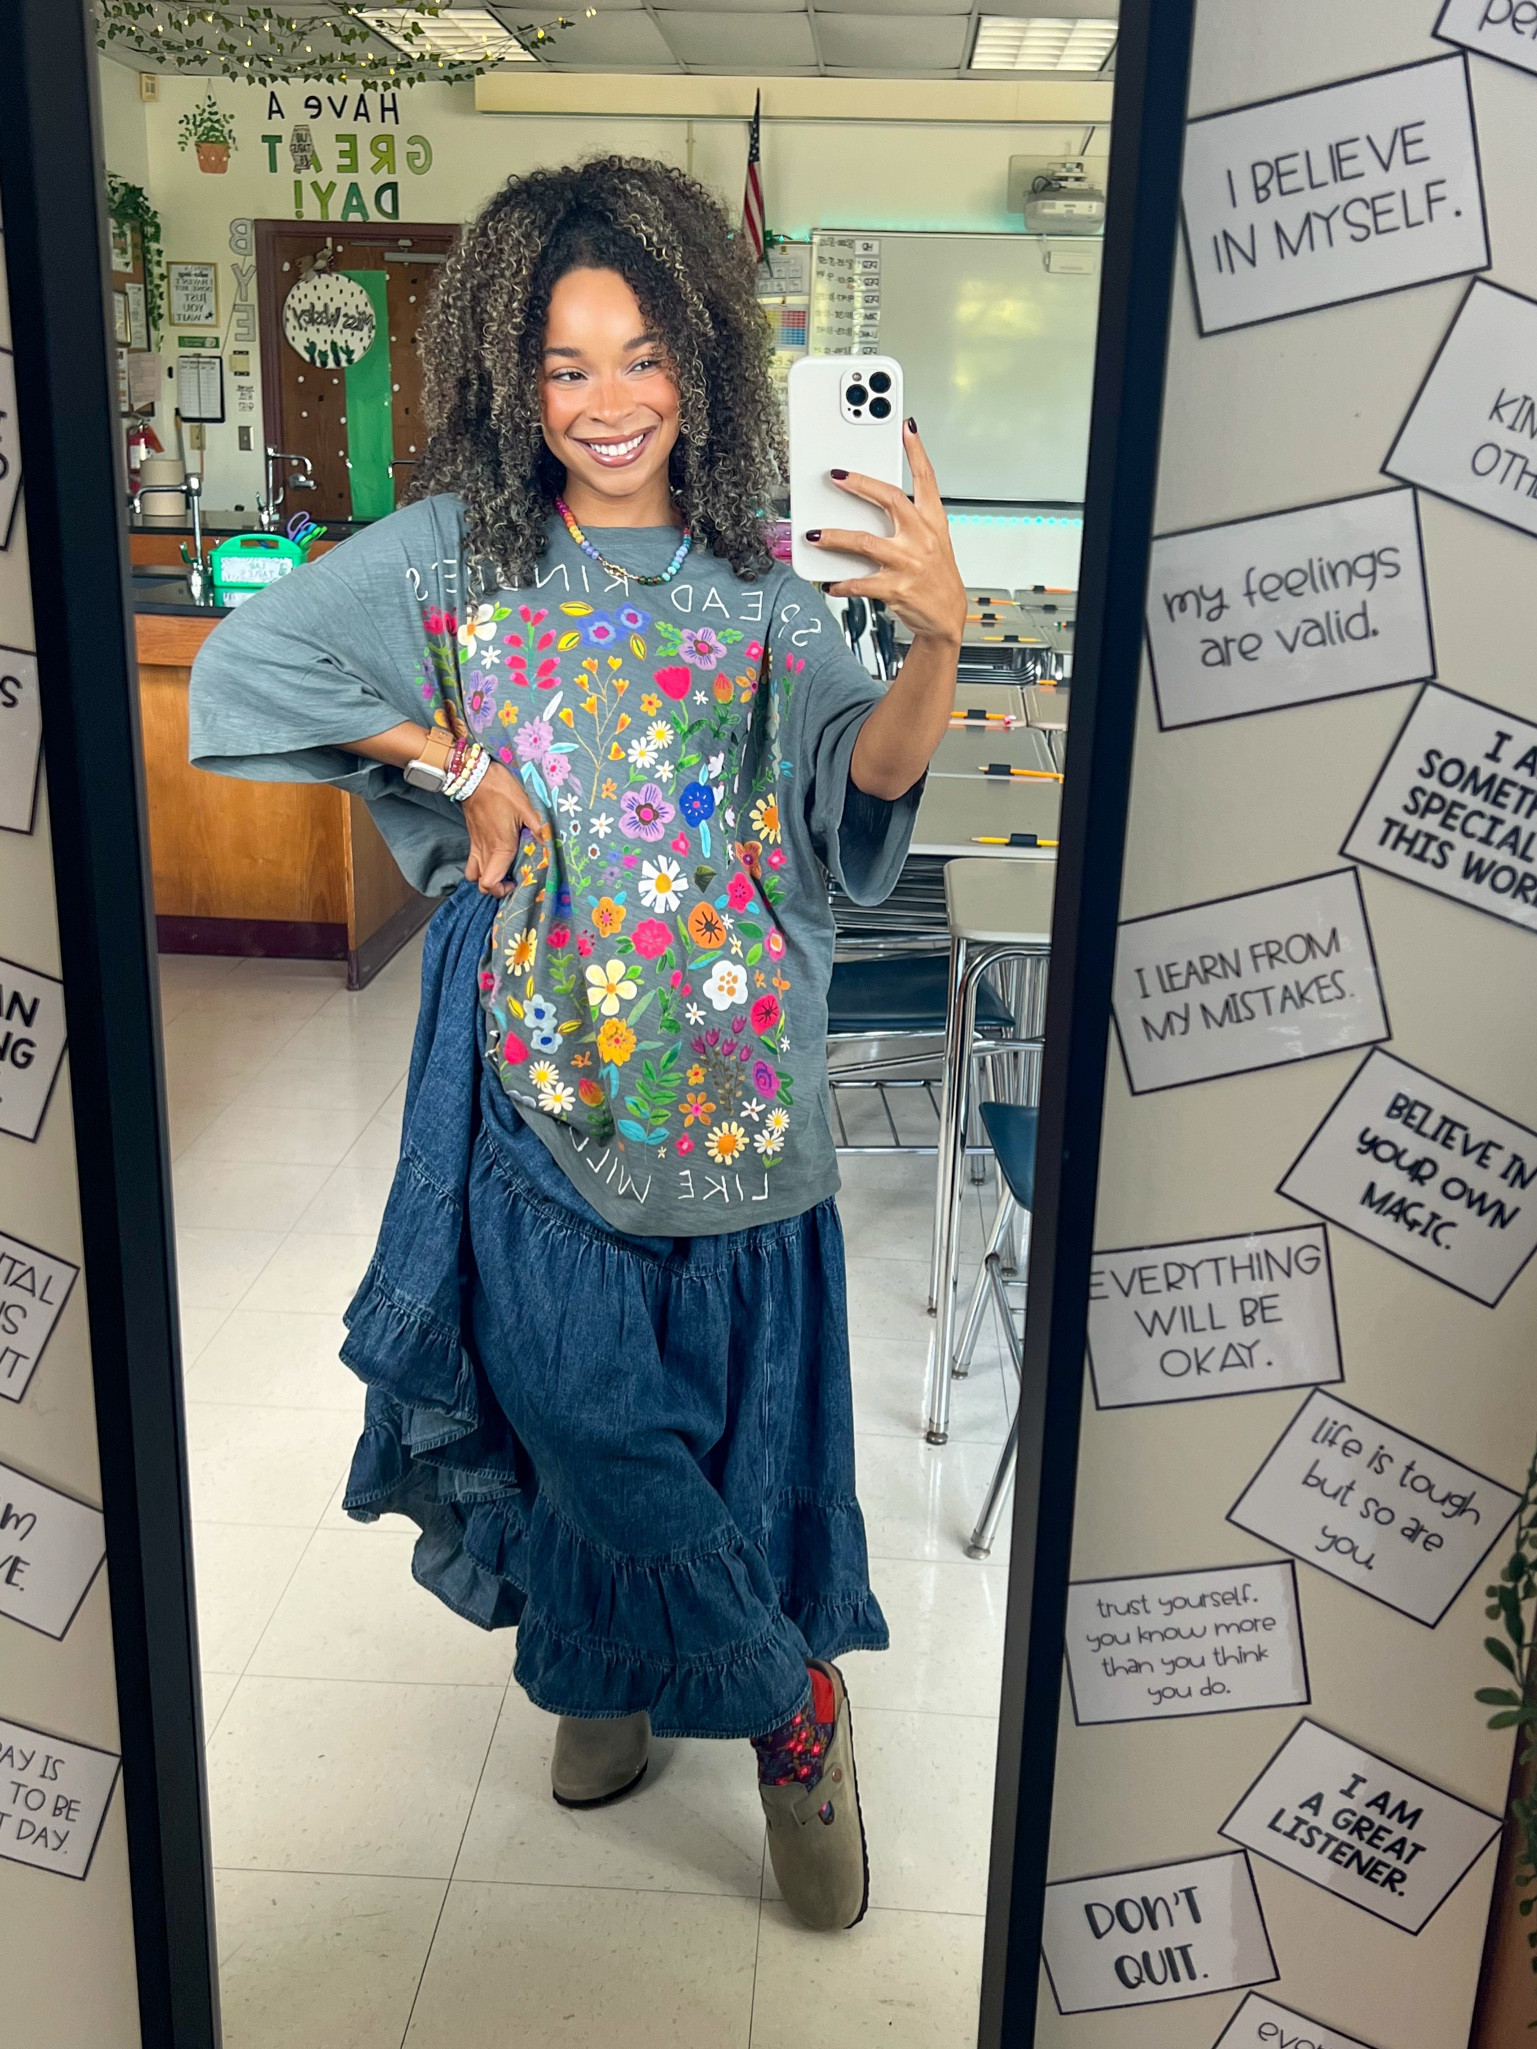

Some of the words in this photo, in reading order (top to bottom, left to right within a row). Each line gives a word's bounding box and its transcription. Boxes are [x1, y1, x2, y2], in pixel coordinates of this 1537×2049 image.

[1478, 0, 1537, 40] pe
[1227, 168, 1238, 208] I
[1251, 120, 1430, 204] BELIEVE
[1213, 223, 1256, 275] IN
[1275, 179, 1463, 260] MYSELF.
[1471, 442, 1537, 500] OTH
[1163, 584, 1230, 622] my
[1243, 546, 1401, 608] feelings
[1200, 632, 1263, 667] are
[1275, 600, 1380, 654] valid.
[1483, 730, 1513, 763] I
[1402, 786, 1537, 863] SPECIAL
[1378, 816, 1456, 869] THIS
[1461, 850, 1537, 906] WOR
[1134, 967, 1149, 999] I
[1156, 948, 1242, 994] LEARN
[1249, 926, 1341, 974] FROM
[1141, 1002, 1190, 1042] MY
[1200, 969, 1356, 1030] MISTAKES.
[1385, 1092, 1504, 1169] BELIEVE
[1499, 1153, 1537, 1190] IN
[1359, 1181, 1460, 1250] MAGIC.
[1440, 1176, 1521, 1229] OWN
[0, 1252, 54, 1305] TAL
[1089, 1244, 1321, 1300] EVERYTHING
[1135, 1302, 1226, 1338] WILL
[1240, 1294, 1283, 1327] BE
[1160, 1339, 1273, 1378] OKAY.
[1311, 1416, 1363, 1459] life
[1367, 1445, 1395, 1475] is
[1399, 1460, 1481, 1525] tough
[1302, 1459, 1356, 1508] but
[1360, 1494, 1396, 1526] so
[1400, 1517, 1444, 1552] are
[1096, 1592, 1150, 1620] trust
[1159, 1583, 1259, 1614] yourself.
[1086, 1629, 1131, 1653] you
[1136, 1622, 1207, 1645] know
[1214, 1615, 1277, 1637] more
[1101, 1655, 1154, 1679] than
[1163, 1651, 1206, 1678] you
[1212, 1644, 1270, 1668] think
[1147, 1683, 1193, 1705] you
[1199, 1676, 1232, 1698] do.
[0, 1742, 36, 1772] AY
[39, 1754, 66, 1781] IS
[10, 1780, 46, 1811] TO
[52, 1794, 81, 1822] BE
[1298, 1792, 1325, 1817] A
[1331, 1807, 1426, 1866] GREAT
[1339, 1772, 1367, 1799] I
[1365, 1789, 1424, 1831] AM
[16, 1818, 70, 1854] DAY.
[1267, 1807, 1411, 1897] LISTENER.
[1114, 1944, 1209, 1991] QUIT.
